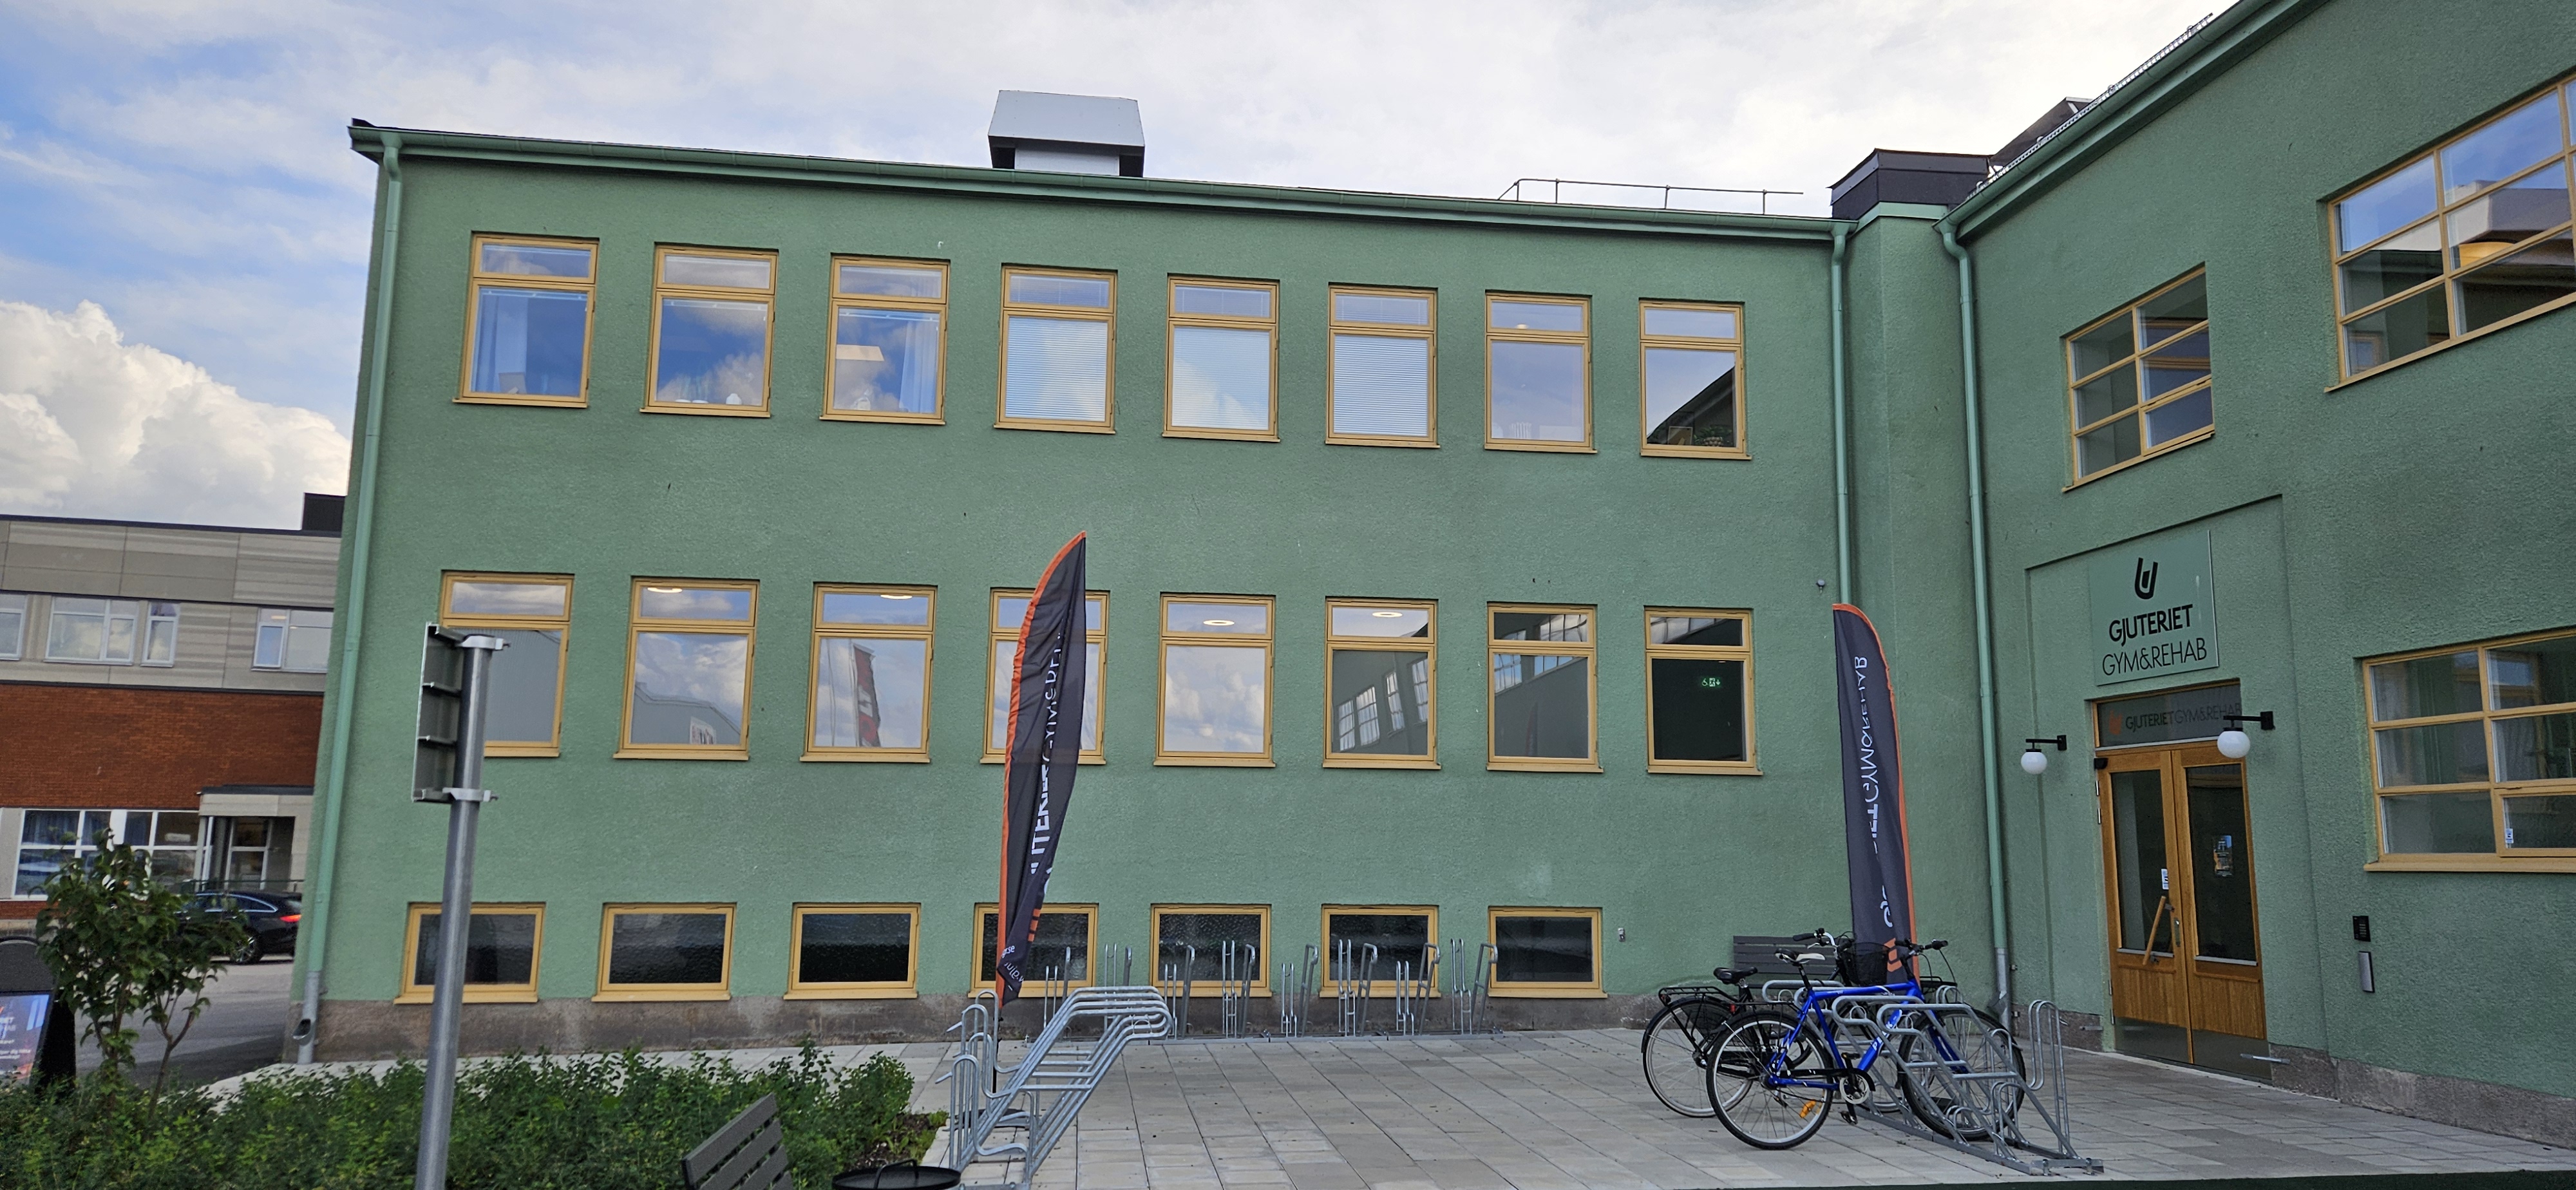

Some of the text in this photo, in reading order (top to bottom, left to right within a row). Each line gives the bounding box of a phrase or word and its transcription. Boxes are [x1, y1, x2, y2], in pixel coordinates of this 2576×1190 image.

[2108, 603, 2193, 647] GJUTERIET
[2102, 638, 2208, 675] GYM&REHAB
[2125, 711, 2174, 733] GJUTERIET
